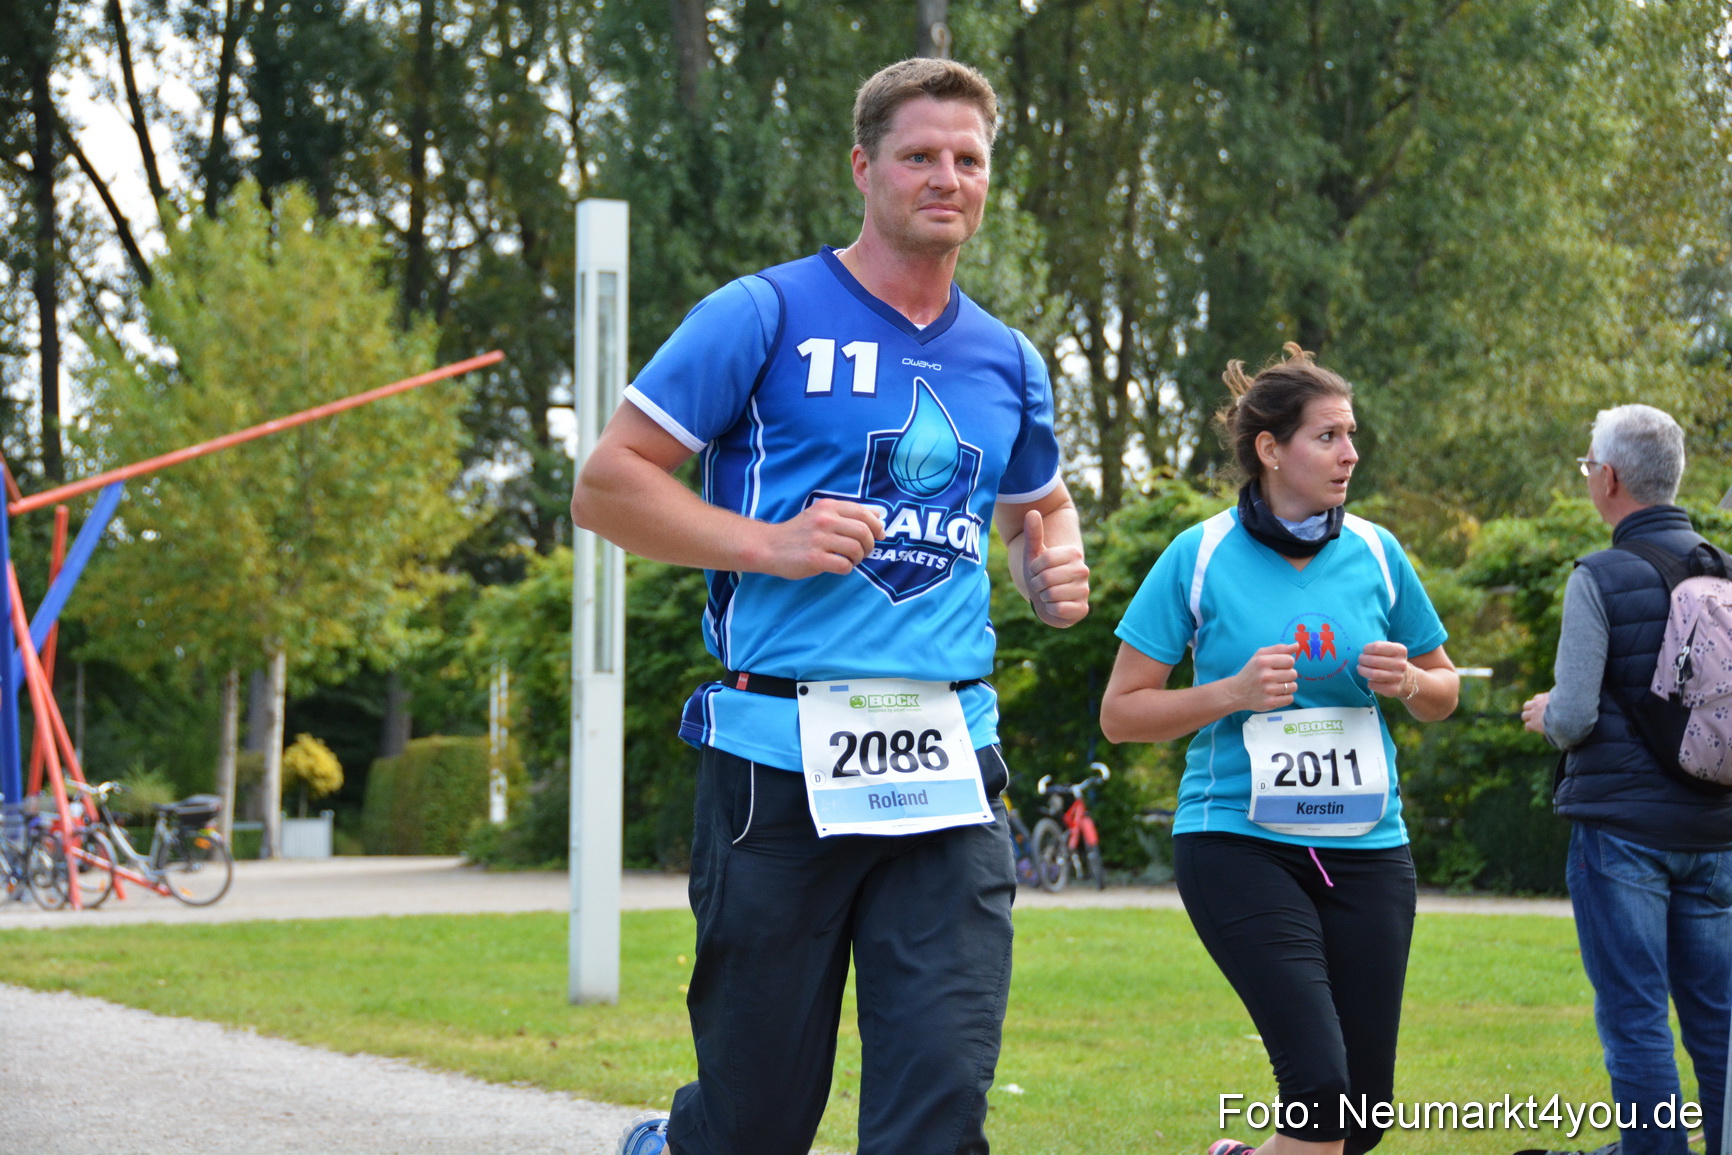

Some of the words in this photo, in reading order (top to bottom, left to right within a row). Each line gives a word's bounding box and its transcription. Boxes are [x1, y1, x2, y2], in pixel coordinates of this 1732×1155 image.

[797, 338, 878, 394] 11
[867, 547, 949, 570] BASKETS
[868, 694, 920, 708] BOCK
[1298, 720, 1344, 733] BOCK
[829, 728, 949, 778] 2086
[1271, 748, 1362, 787] 2011
[814, 774, 821, 783] D
[1260, 782, 1266, 790] D
[868, 789, 929, 810] Roland
[1296, 802, 1344, 815] Kerstin
